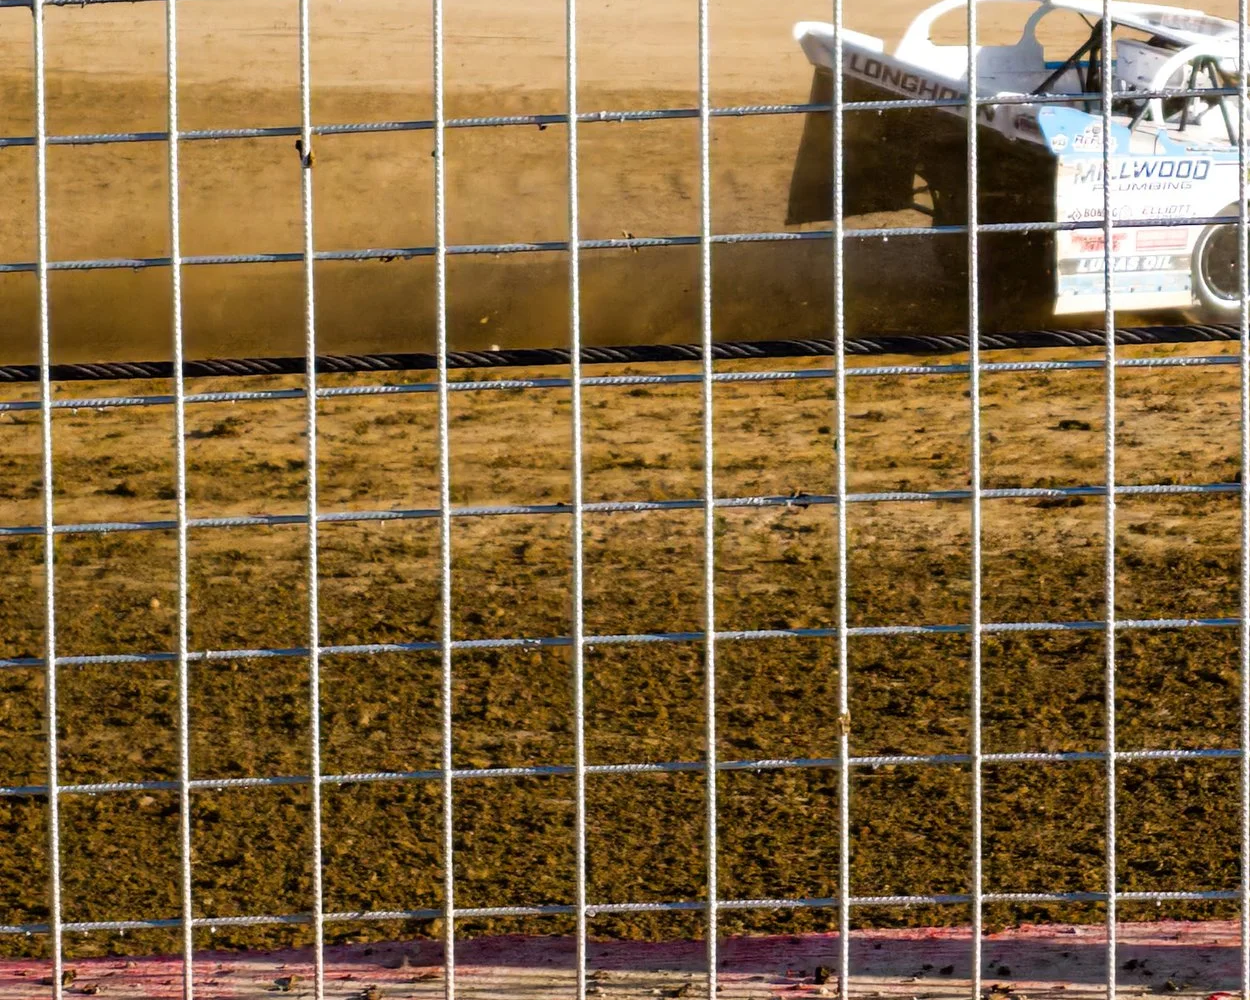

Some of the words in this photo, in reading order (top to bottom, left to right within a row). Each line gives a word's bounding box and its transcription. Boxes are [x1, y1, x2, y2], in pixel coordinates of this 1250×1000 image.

[1073, 159, 1211, 185] MILWOOD
[1092, 181, 1192, 192] PUMBING
[1077, 255, 1140, 273] LUAS
